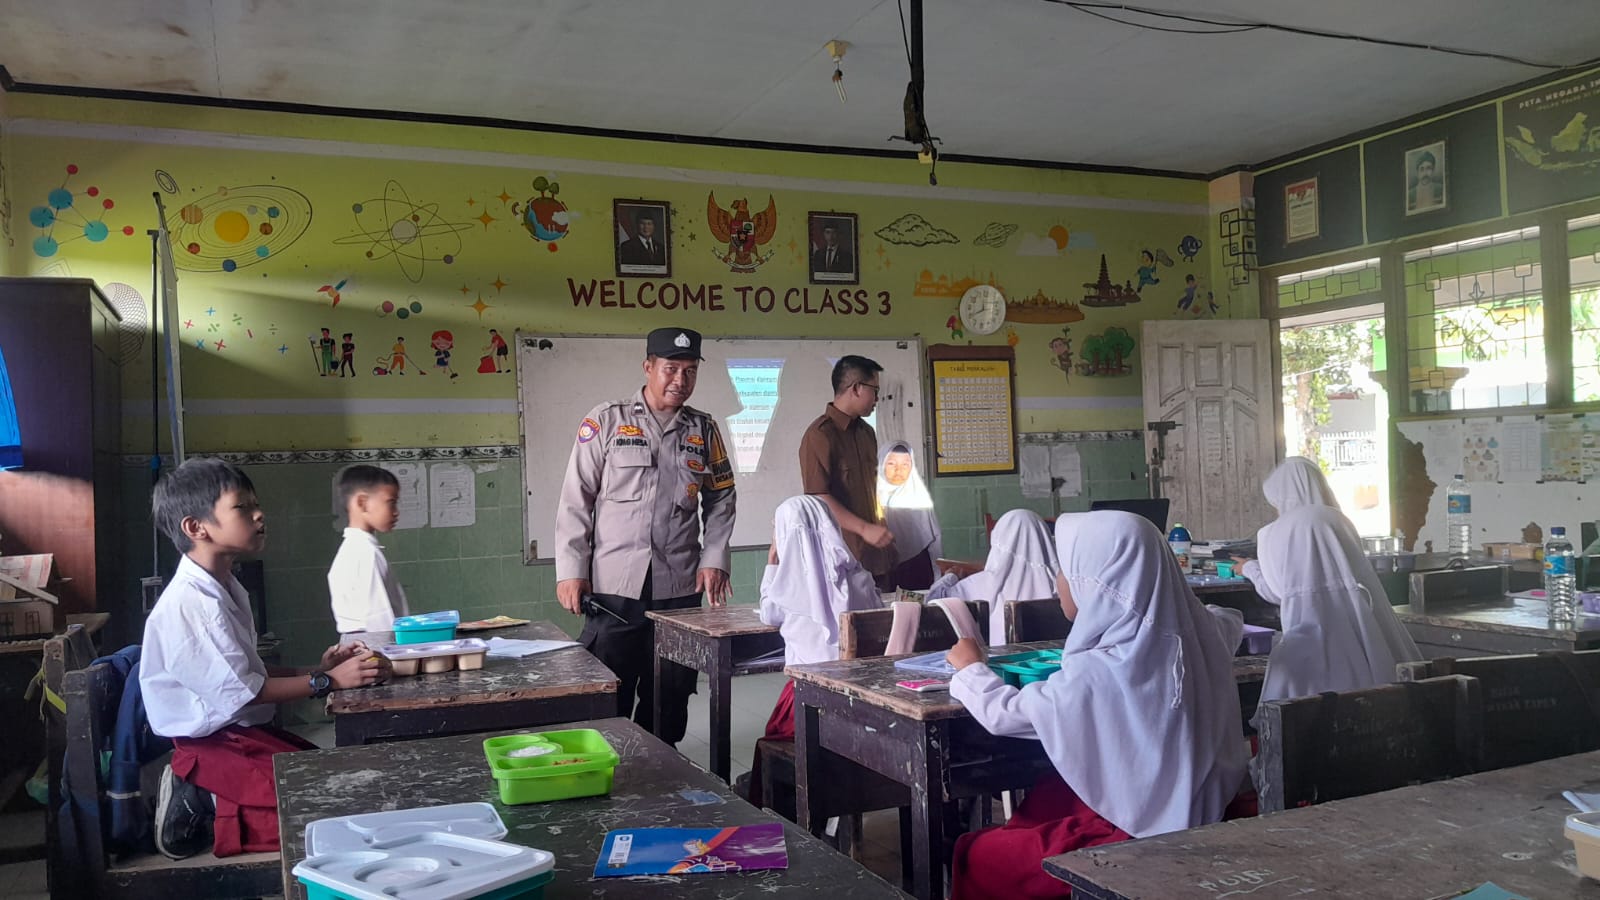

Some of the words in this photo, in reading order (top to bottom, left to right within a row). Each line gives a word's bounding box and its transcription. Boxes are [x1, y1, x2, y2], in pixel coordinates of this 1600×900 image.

[1519, 97, 1541, 109] PETA
[1545, 84, 1586, 101] NEGARA
[566, 278, 725, 311] WELCOME
[733, 286, 776, 313] TO
[783, 288, 869, 315] CLASS
[877, 291, 892, 316] 3
